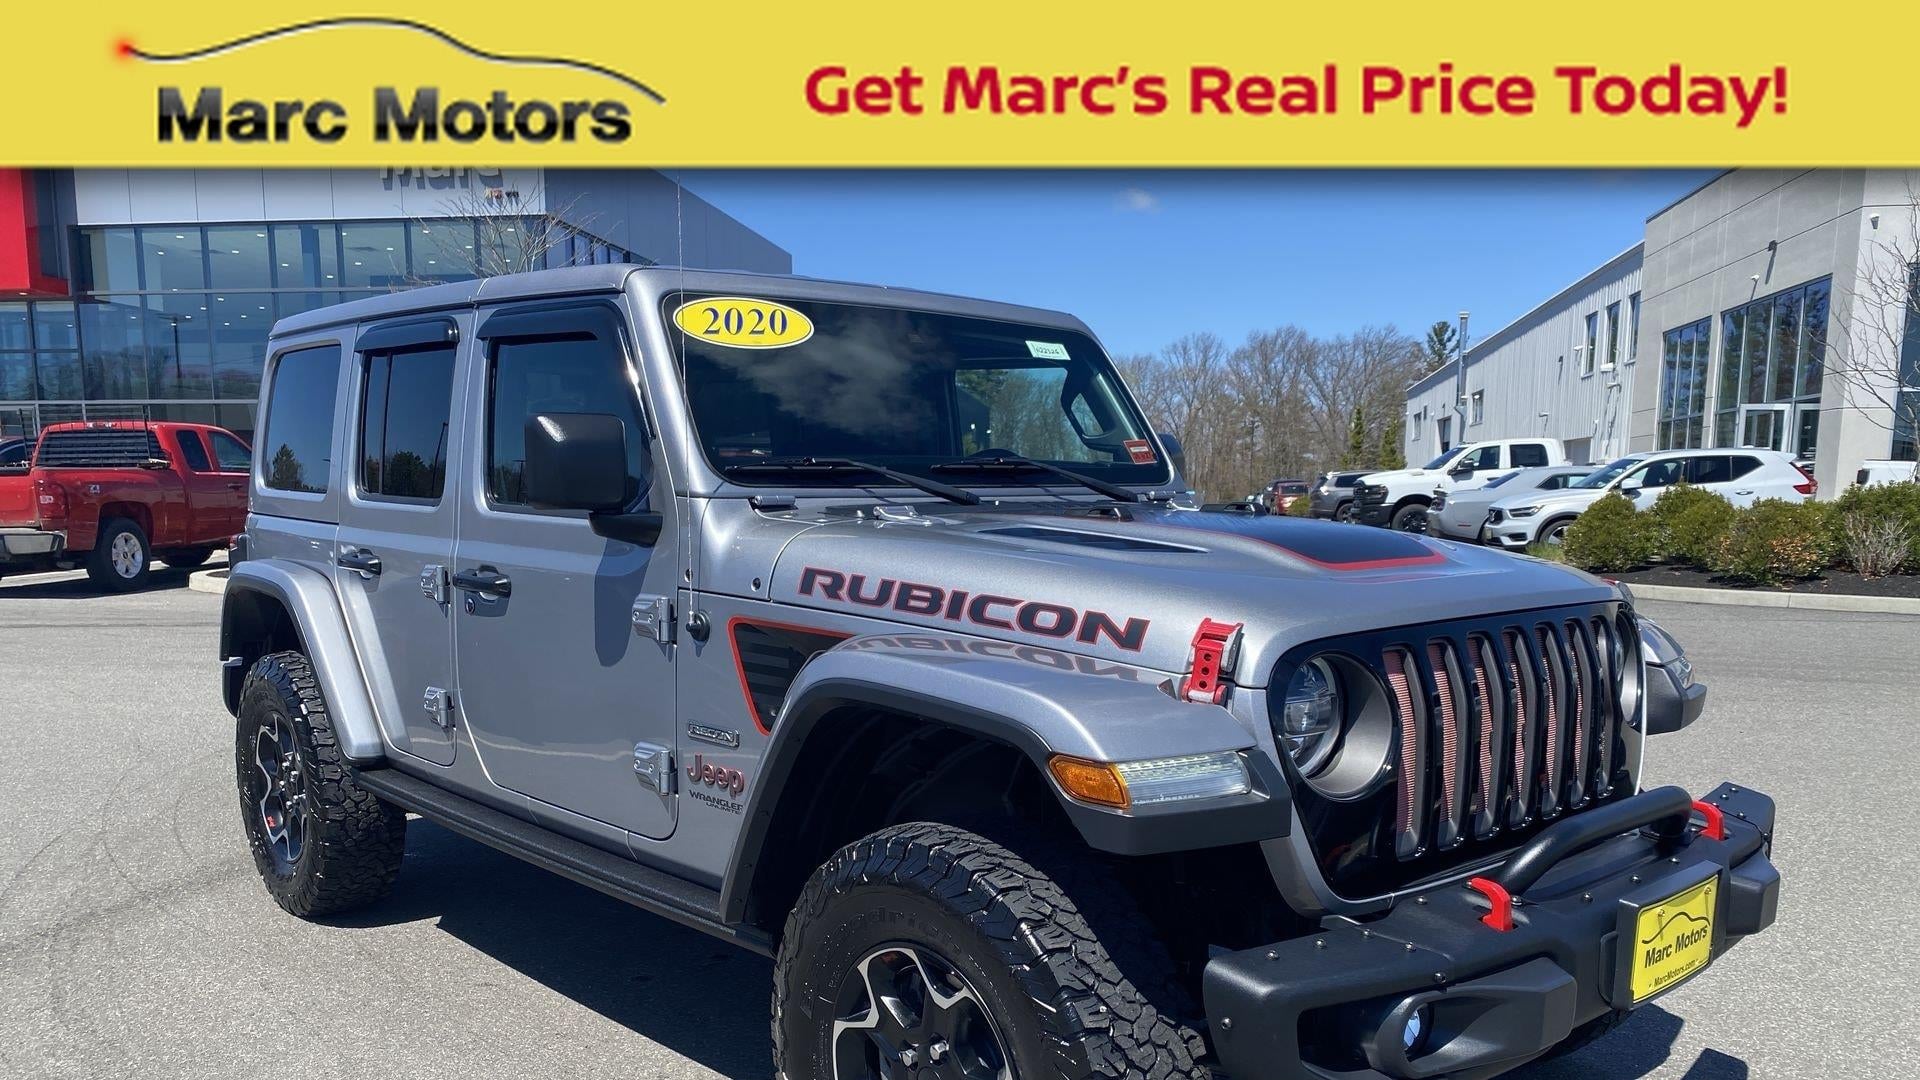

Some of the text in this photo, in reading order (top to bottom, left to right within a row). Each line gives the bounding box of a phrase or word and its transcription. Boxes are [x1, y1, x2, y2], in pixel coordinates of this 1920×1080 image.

[702, 307, 788, 336] 2020
[798, 566, 1151, 652] RUBICON
[686, 752, 745, 799] Jeep
[1645, 925, 1708, 969] Marc Motors
